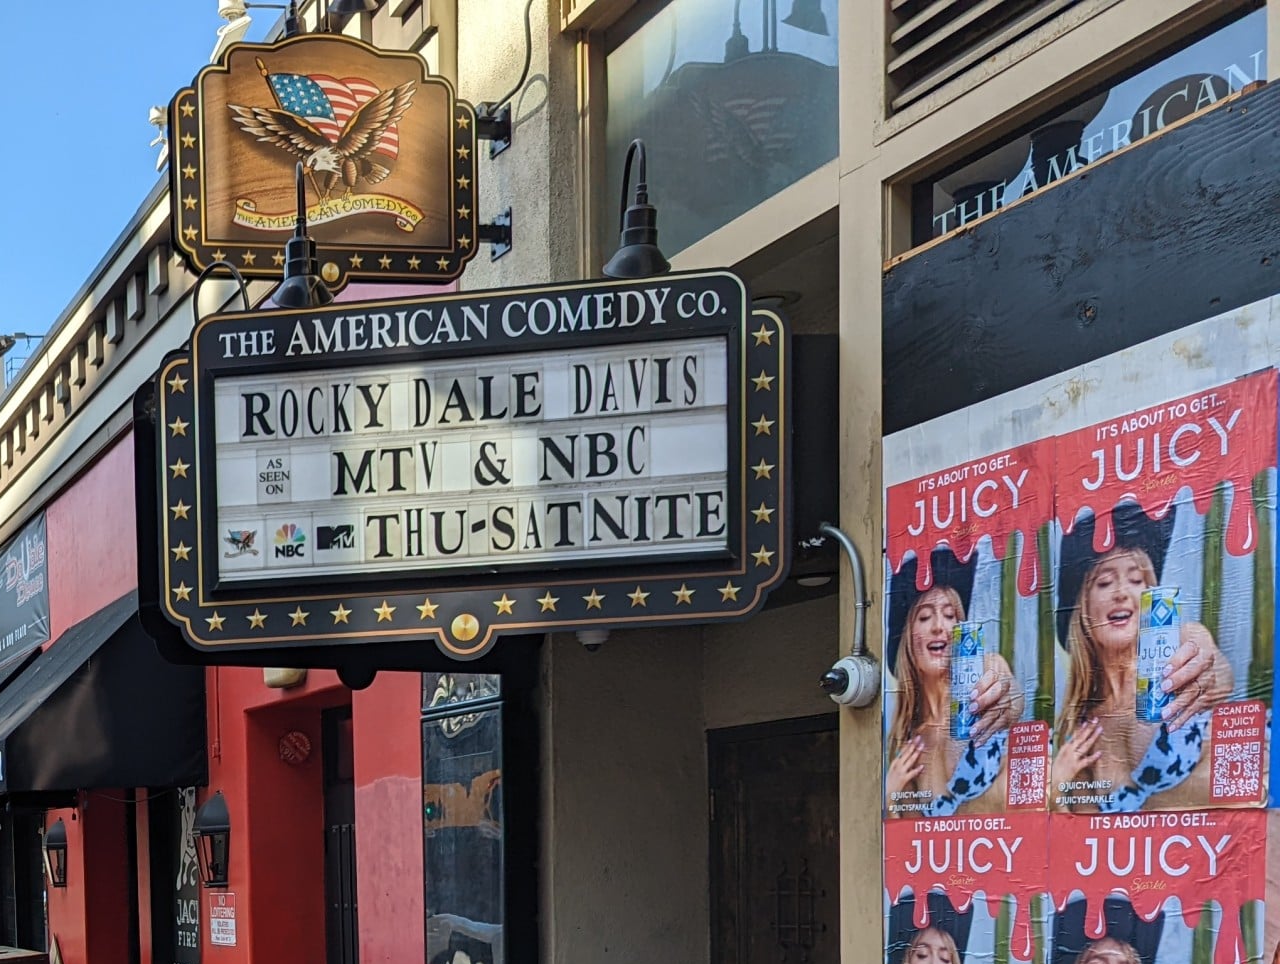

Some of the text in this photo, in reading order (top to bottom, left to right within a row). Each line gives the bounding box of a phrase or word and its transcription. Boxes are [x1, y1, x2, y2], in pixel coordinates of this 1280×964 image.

[237, 213, 253, 224] THE
[255, 204, 340, 229] AMERCAN
[342, 199, 407, 213] COMEDY
[219, 287, 727, 359] THE AMERICAN COMEDY CO.
[241, 355, 698, 437] ROCKY DALE DAVIS
[1096, 393, 1227, 442] IT'S ABOUT TO GET...
[1081, 408, 1242, 491] JUICY
[266, 458, 282, 469] AS
[333, 425, 646, 496] MTV & NBC
[259, 470, 290, 483] SEEN
[918, 454, 1017, 494] IT'S ABOUT TO GET...
[265, 483, 284, 495] ON
[907, 469, 1029, 537] JUICY
[275, 544, 304, 558] NBC
[1218, 704, 1260, 716] SCAN FOR
[1012, 724, 1045, 734] SCAN FOR
[1231, 716, 1255, 729] JUICY
[1021, 735, 1041, 745] JUICY
[1216, 728, 1260, 739] SURPRISE!
[1058, 780, 1112, 793] @JUICYWINES
[1055, 795, 1114, 807] #JUICYSPARKLE
[914, 818, 1011, 832] IT'S ABOUT TO GET...
[1090, 813, 1217, 830] IT'S ABOUT TO GET...
[904, 837, 1023, 874] JUICY
[1075, 834, 1232, 877] JUICY
[218, 895, 226, 906] NO
[178, 930, 197, 948] FIRE
